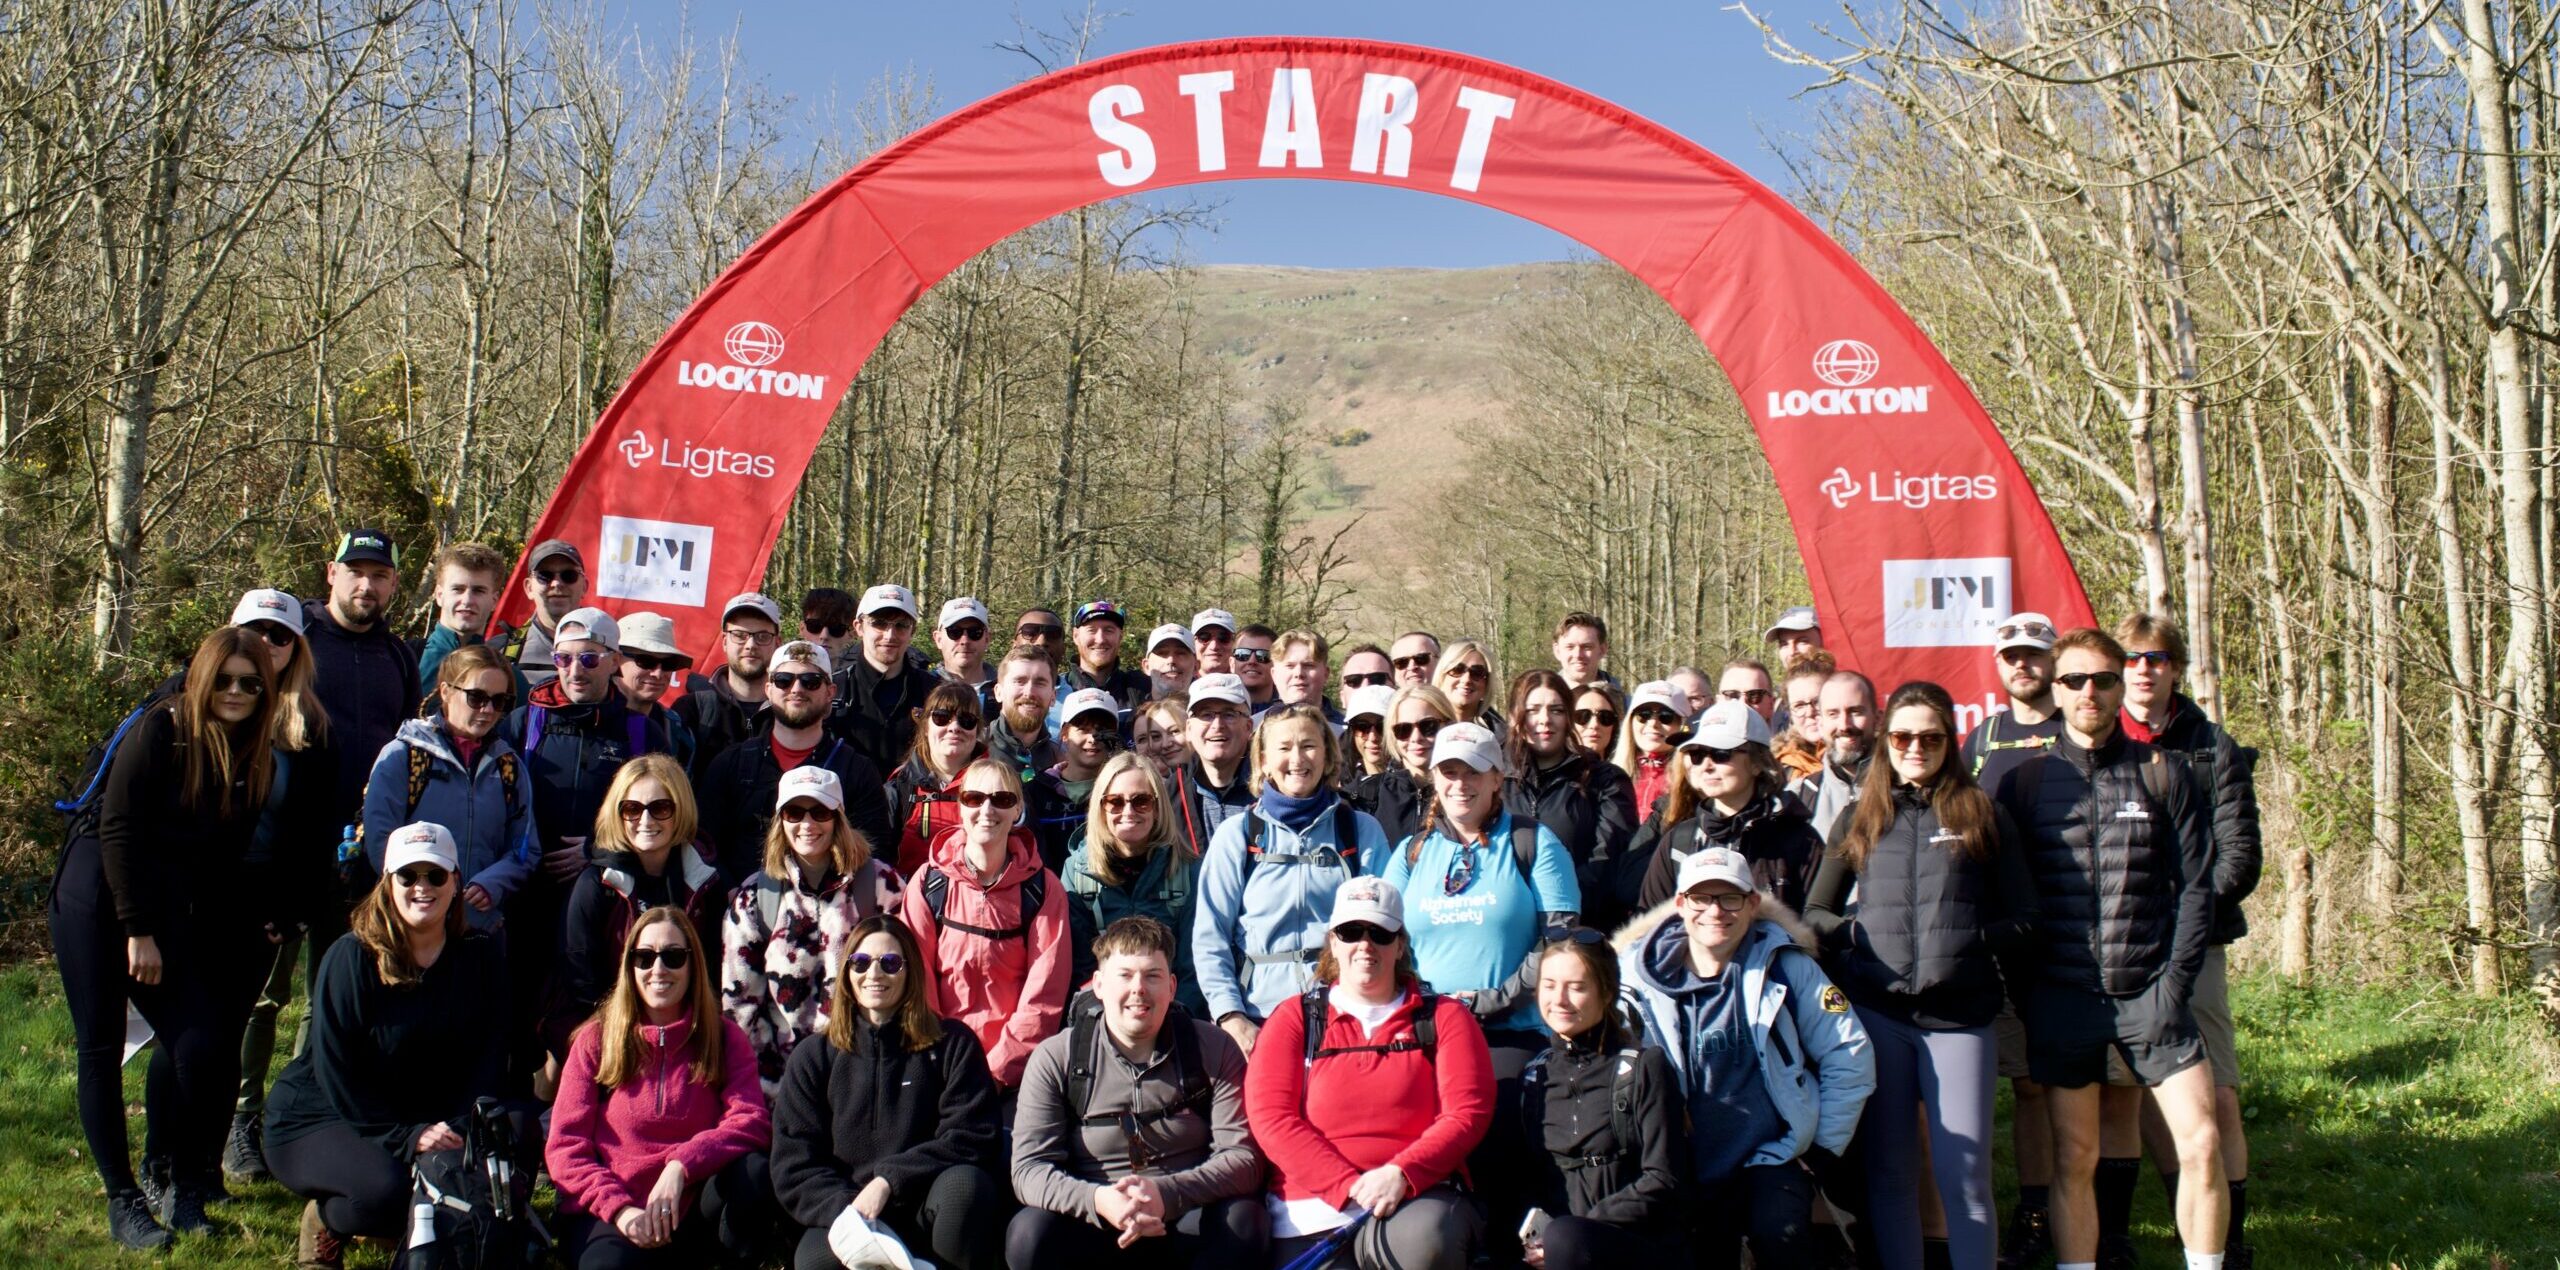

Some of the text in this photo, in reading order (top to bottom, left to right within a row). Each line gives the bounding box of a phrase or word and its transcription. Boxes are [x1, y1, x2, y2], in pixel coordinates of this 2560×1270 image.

[1088, 68, 1516, 192] START
[678, 360, 824, 400] LOCKTON
[1768, 386, 1928, 418] LOCKTON
[661, 438, 775, 478] Ligtas
[1870, 471, 1998, 508] Ligtas
[610, 533, 695, 572] JFM
[1904, 575, 1994, 610] JFM
[1420, 891, 1496, 912] Alzheimer's
[1431, 908, 1483, 925] Society
